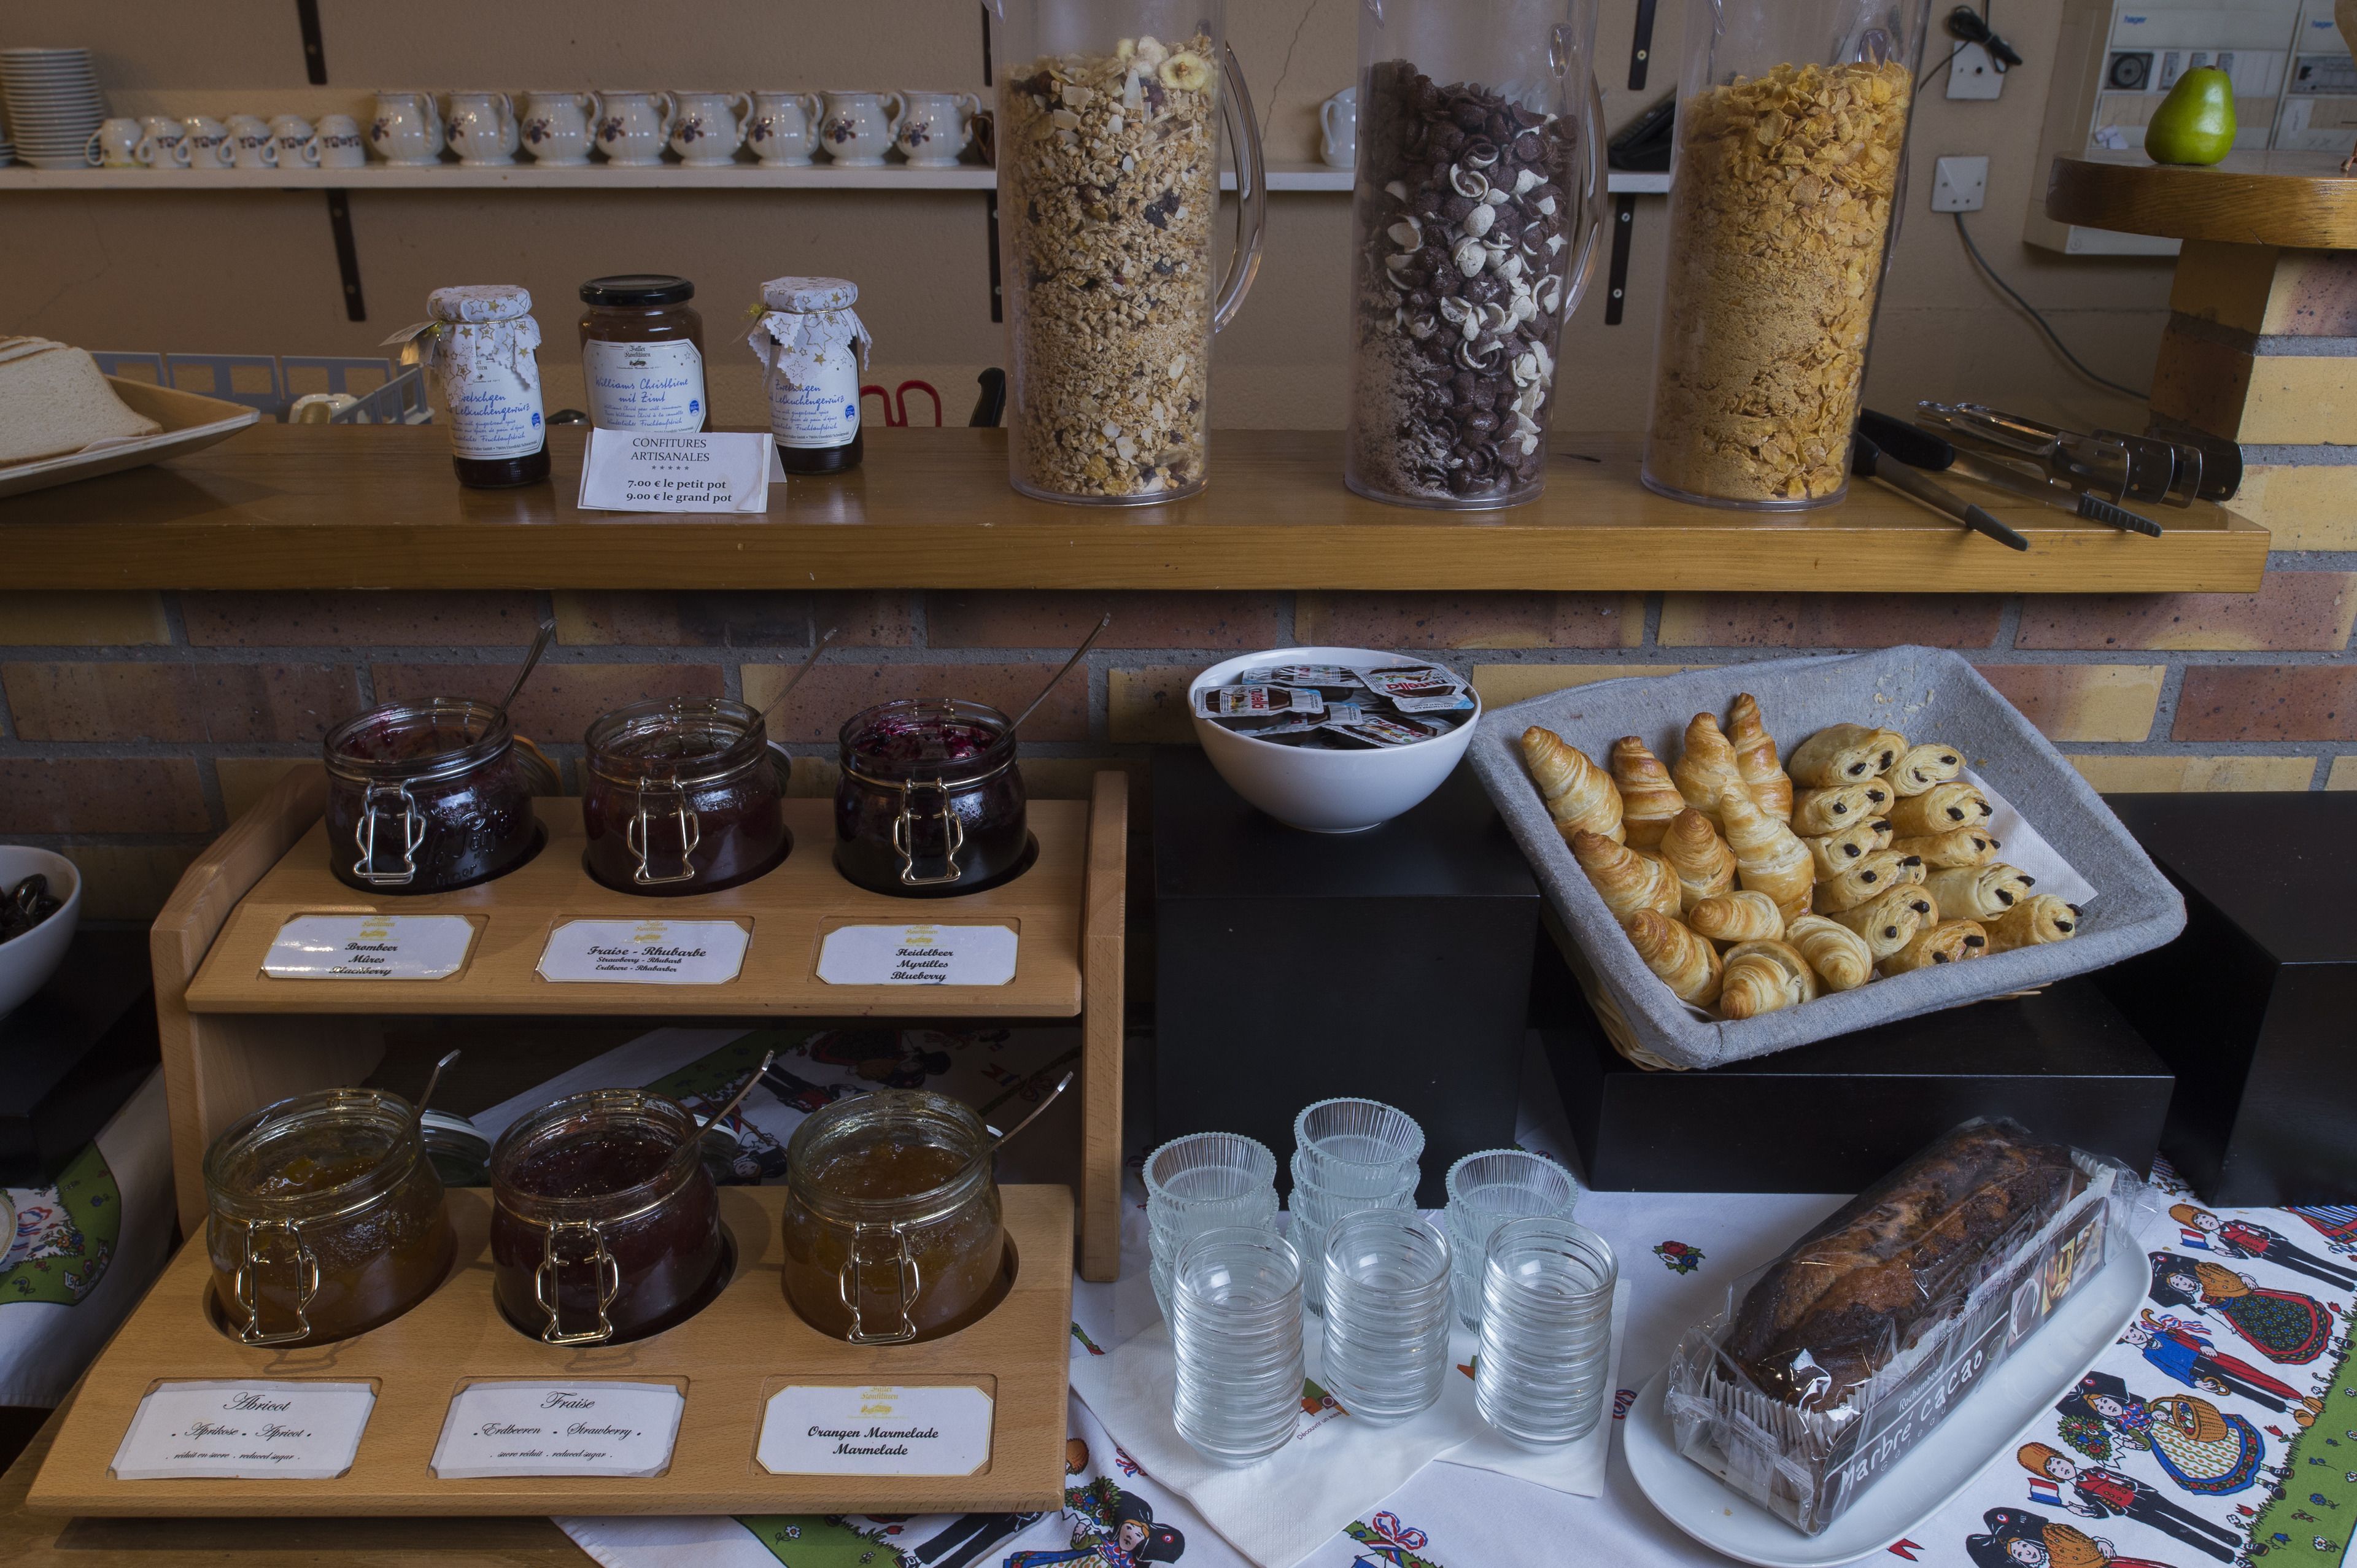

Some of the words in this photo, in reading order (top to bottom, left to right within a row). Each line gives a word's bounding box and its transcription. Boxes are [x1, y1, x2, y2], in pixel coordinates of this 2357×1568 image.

[595, 376, 635, 389] Williams
[640, 379, 689, 389] Christbirne
[618, 393, 637, 403] mit
[641, 392, 666, 403] Zimt
[633, 438, 706, 448] CONFITURES
[630, 452, 710, 462] ARTISANALES
[628, 480, 651, 489] 7.00
[663, 479, 674, 488] le
[677, 479, 704, 490] petit
[707, 481, 727, 491] pot
[663, 492, 673, 501] le
[676, 493, 710, 503] grand
[713, 493, 732, 504] pot
[1386, 679, 1448, 692] nutella
[1251, 688, 1268, 709] nutella
[1369, 718, 1425, 738] nutella
[344, 942, 398, 952] Brombeer
[587, 946, 629, 955] Fraise
[641, 946, 706, 957] Rhubarbe
[896, 948, 954, 957] Heidelbeer
[348, 955, 385, 964] Mûres
[596, 956, 640, 965] Strawberry
[896, 959, 949, 970] Myrtilles
[329, 967, 392, 976] Blackberry
[890, 971, 946, 982] Blueberry
[1898, 1364, 1945, 1413] Rochambeau
[223, 1392, 292, 1412] Abricot
[541, 1391, 595, 1410] Fraise
[1840, 1413, 1913, 1496] Marbré
[1921, 1351, 1984, 1426] cacao
[184, 1422, 239, 1440] Aprikose
[255, 1423, 304, 1440] Apricot
[481, 1423, 541, 1436] Erdbeeren
[567, 1423, 633, 1441] Strawberry
[807, 1426, 861, 1441] Orangen
[863, 1427, 939, 1439] Marmelade
[1296, 1420, 1322, 1440] Découvrir
[519, 1449, 543, 1458] réduit
[551, 1449, 582, 1458] reduced
[581, 1450, 606, 1461] sugar
[832, 1443, 908, 1456] Marmelade
[239, 1451, 269, 1460] reduced
[269, 1453, 294, 1463] sugar
